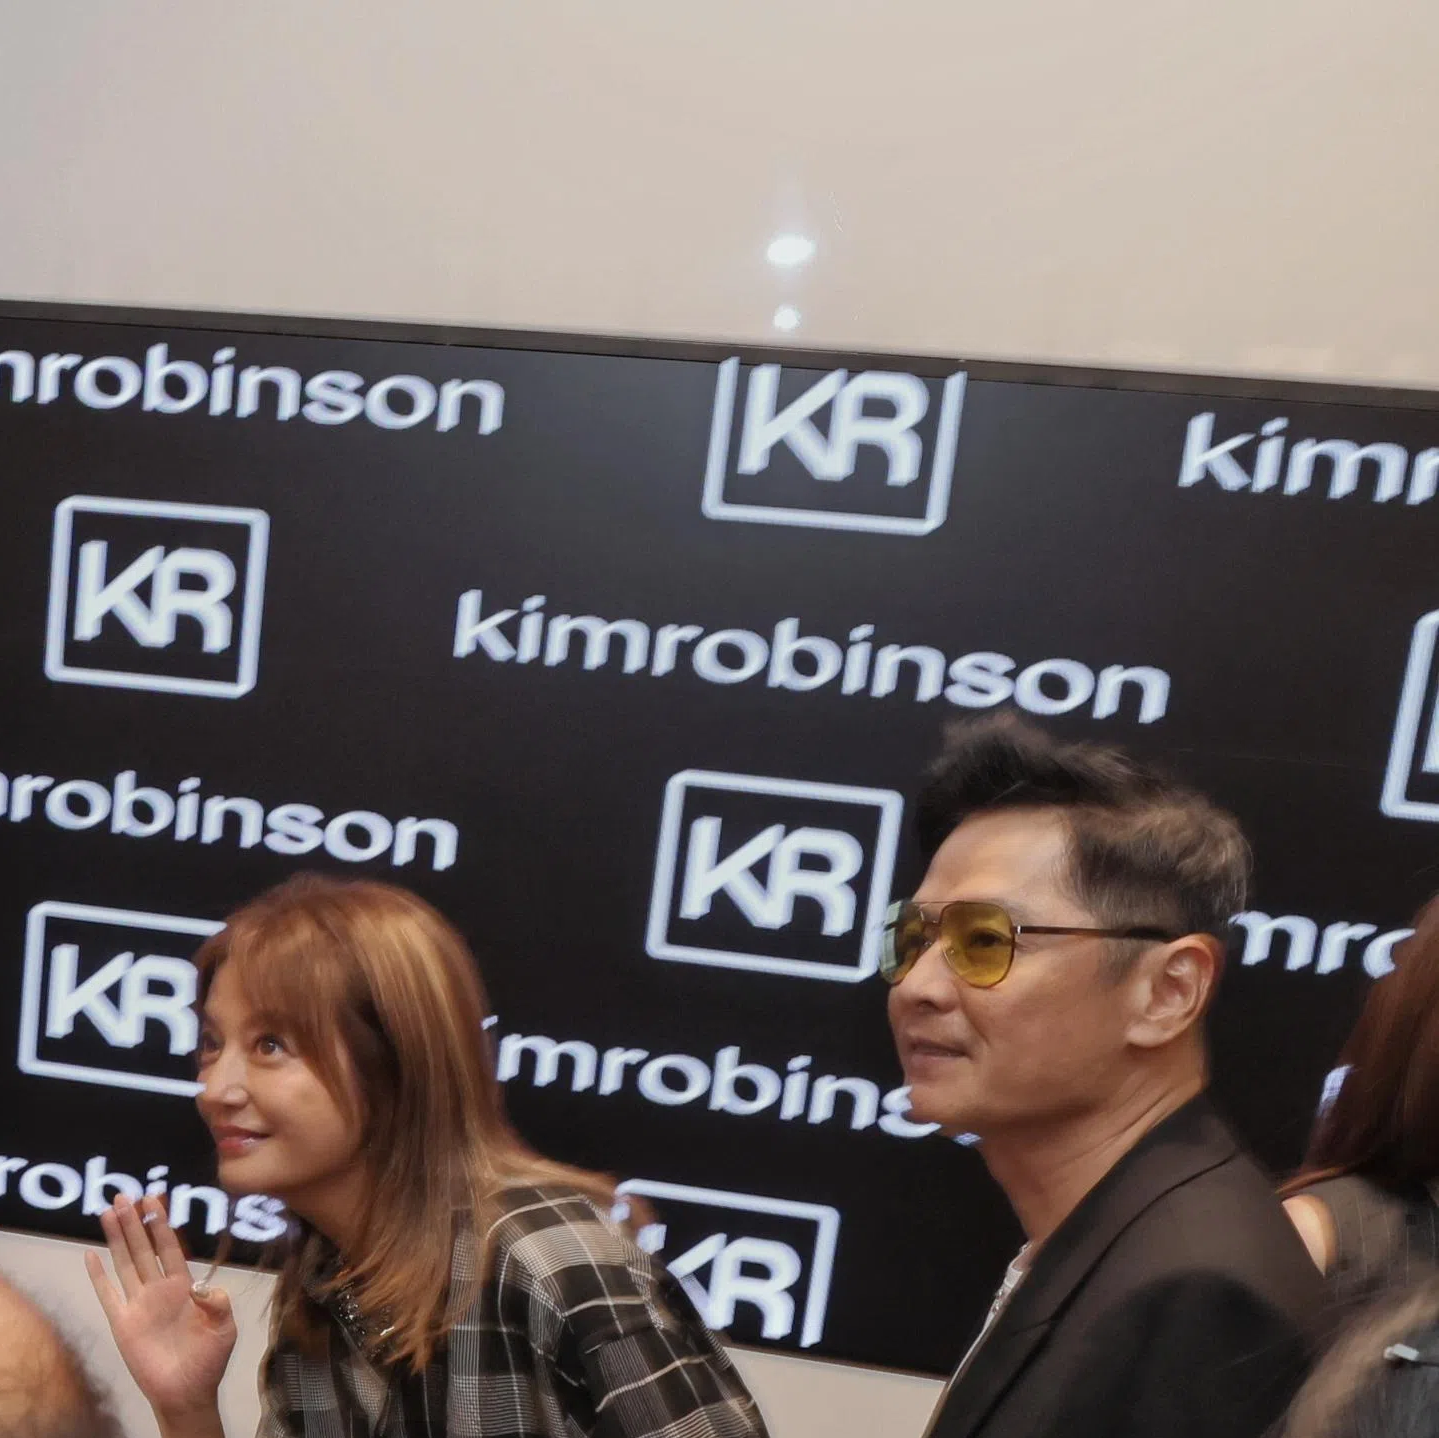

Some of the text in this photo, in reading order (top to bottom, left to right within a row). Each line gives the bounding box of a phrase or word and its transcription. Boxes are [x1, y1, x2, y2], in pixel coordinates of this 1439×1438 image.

[736, 363, 931, 488] KR
[1177, 412, 1439, 505] kimr
[73, 540, 237, 654] KR
[452, 589, 1171, 724] kimrobinson
[679, 815, 864, 938] KR
[45, 943, 200, 1056] KR
[482, 1015, 981, 1145] mrobins
